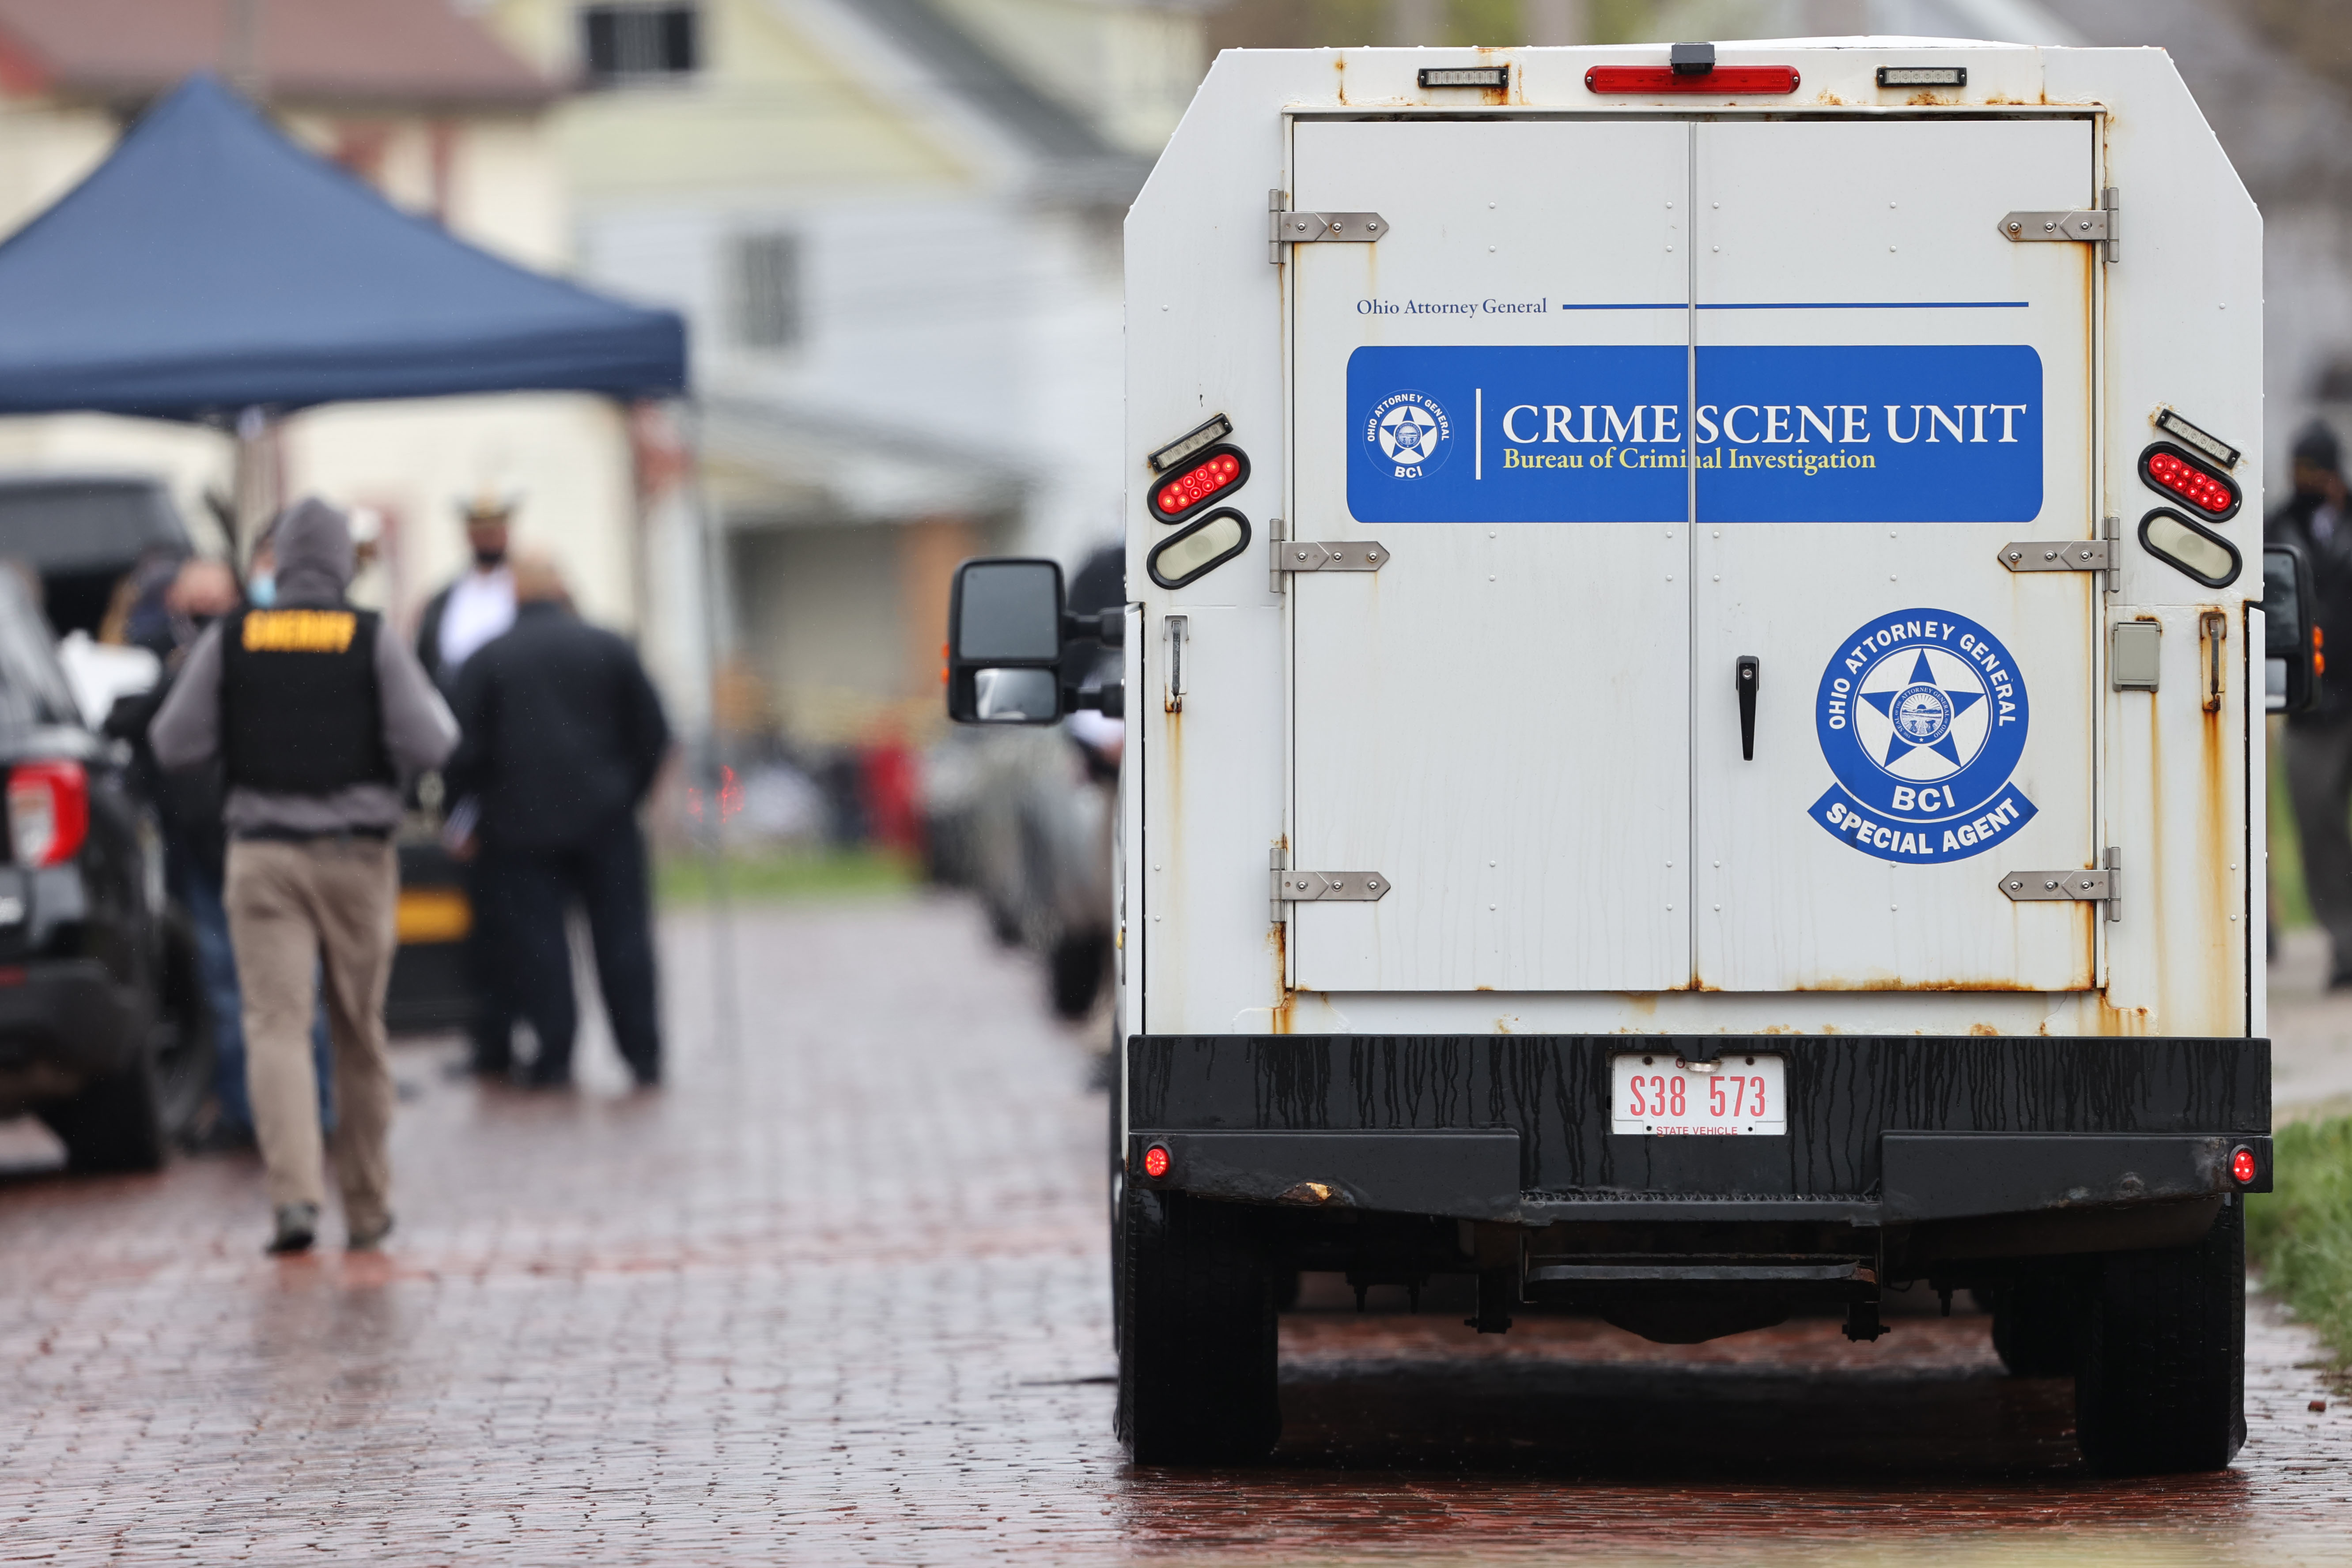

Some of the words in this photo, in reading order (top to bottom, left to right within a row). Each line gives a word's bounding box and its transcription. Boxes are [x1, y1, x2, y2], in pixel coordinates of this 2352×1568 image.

[1357, 298, 1399, 314] Ohio
[1404, 299, 1479, 318] Attorney
[1482, 298, 1547, 314] General
[1367, 418, 1377, 442] OHIO
[1374, 393, 1423, 418] ATTORNEY
[1424, 399, 1449, 441] GENERAL
[1503, 404, 1682, 443] CRIME
[1696, 405, 1871, 444] SCENE
[1883, 404, 2027, 443] UNIT
[1394, 465, 1423, 479] BCI
[1503, 448, 1584, 469] Bureau
[1590, 446, 1617, 469] of
[1619, 446, 1723, 469] Criminal
[1728, 449, 1876, 476] Investigation
[1829, 678, 1851, 729] OHIO
[1845, 620, 1955, 675] ATTORNEY
[1959, 633, 2016, 727] GENERAL
[1901, 687, 1933, 700] ATTORNEY
[1933, 691, 1950, 718] GENERAL
[1933, 724, 1947, 738] OHIO
[1891, 784, 1956, 812] BCI
[1826, 802, 1934, 854] SPECIAL
[1942, 797, 2020, 853] AGENT
[1630, 1075, 1686, 1117] S38
[1710, 1076, 1766, 1117] 573
[1656, 1126, 1689, 1135] STATE
[1693, 1126, 1738, 1135] VEHICLE
